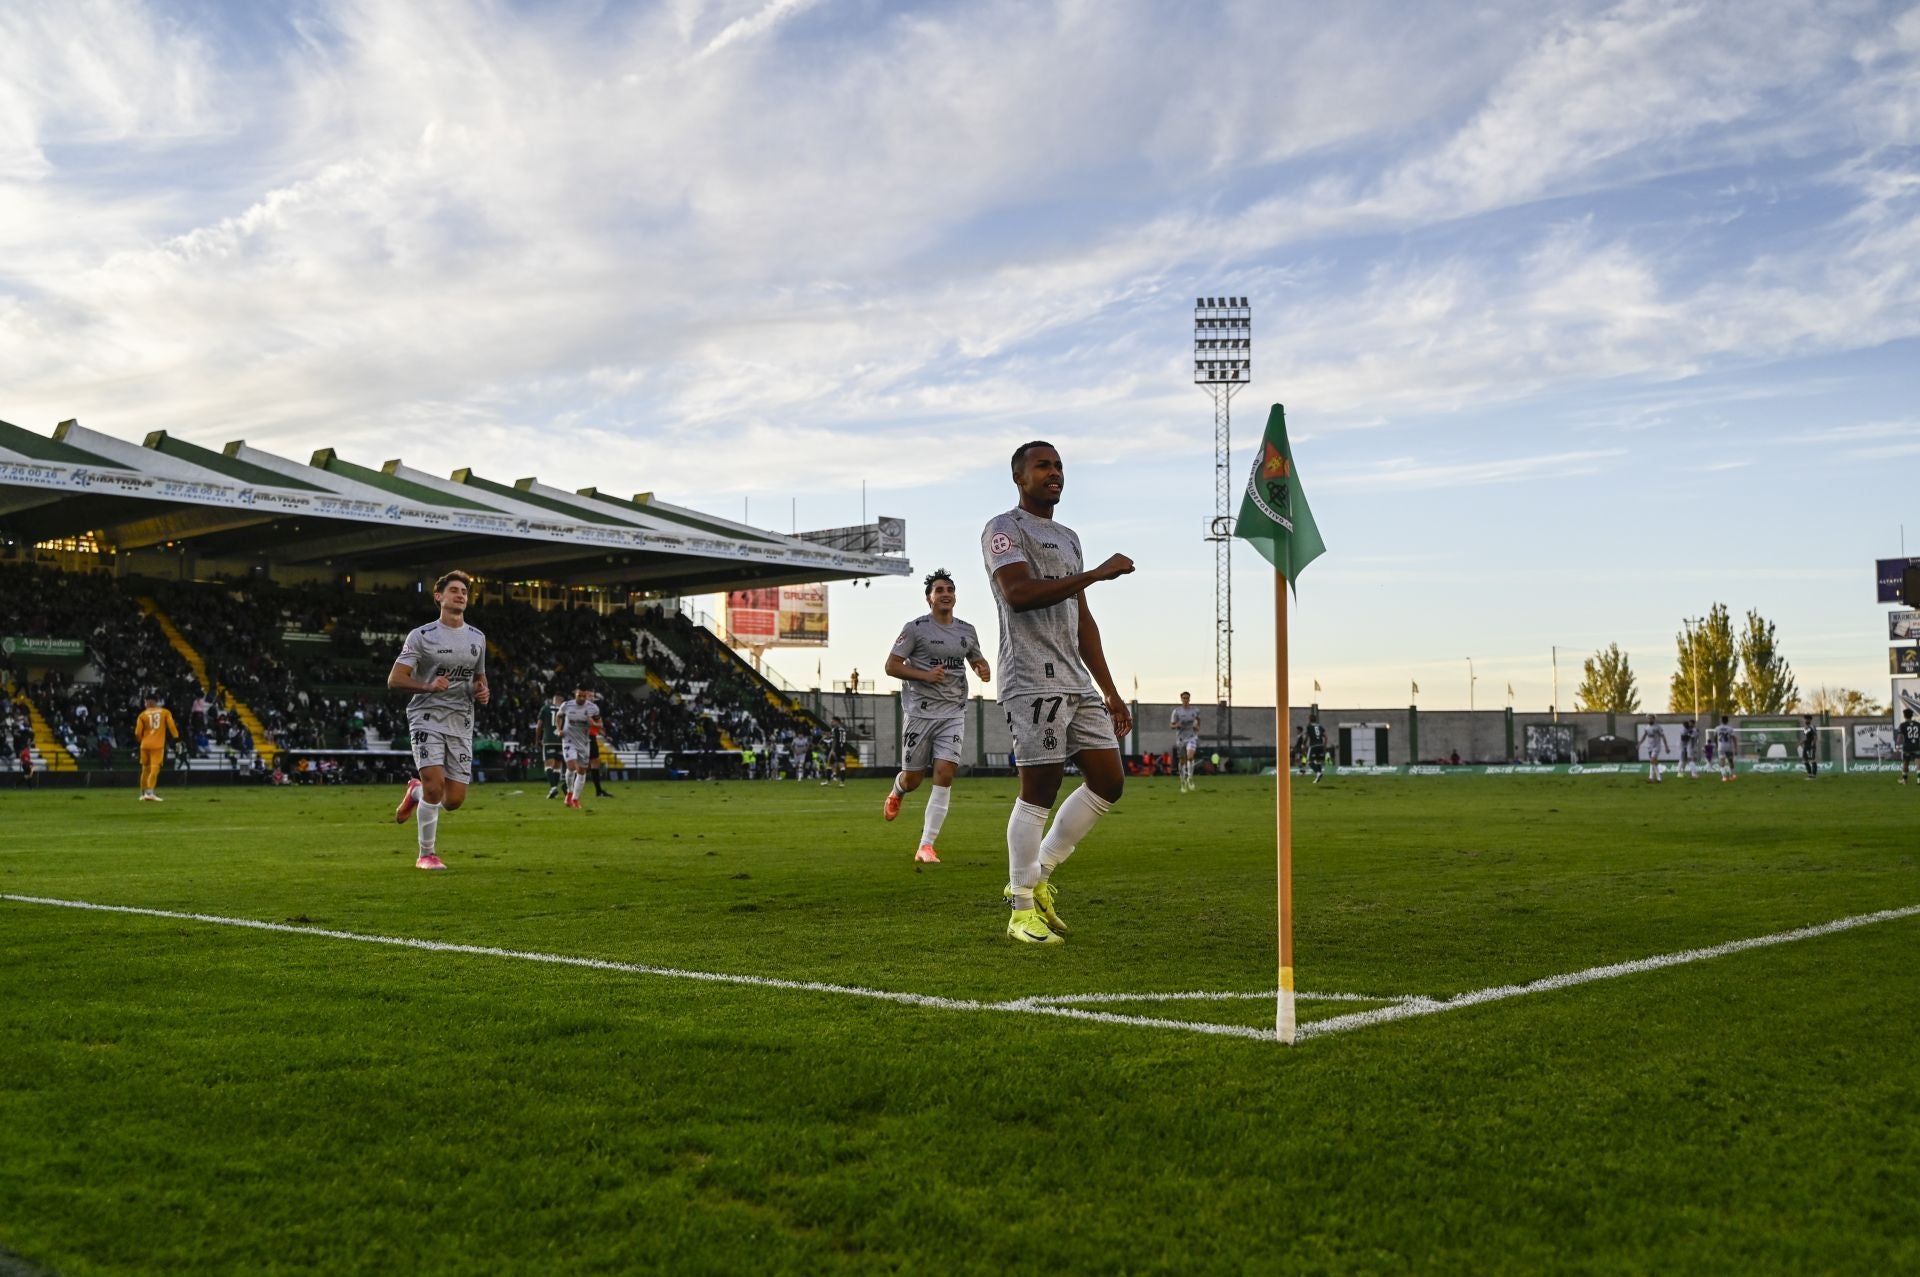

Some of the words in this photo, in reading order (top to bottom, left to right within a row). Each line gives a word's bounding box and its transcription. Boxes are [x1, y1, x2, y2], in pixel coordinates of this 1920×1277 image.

[28, 469, 42, 477] 00
[1031, 696, 1063, 724] 17
[1907, 726, 1919, 739] 22
[904, 732, 920, 748] 18
